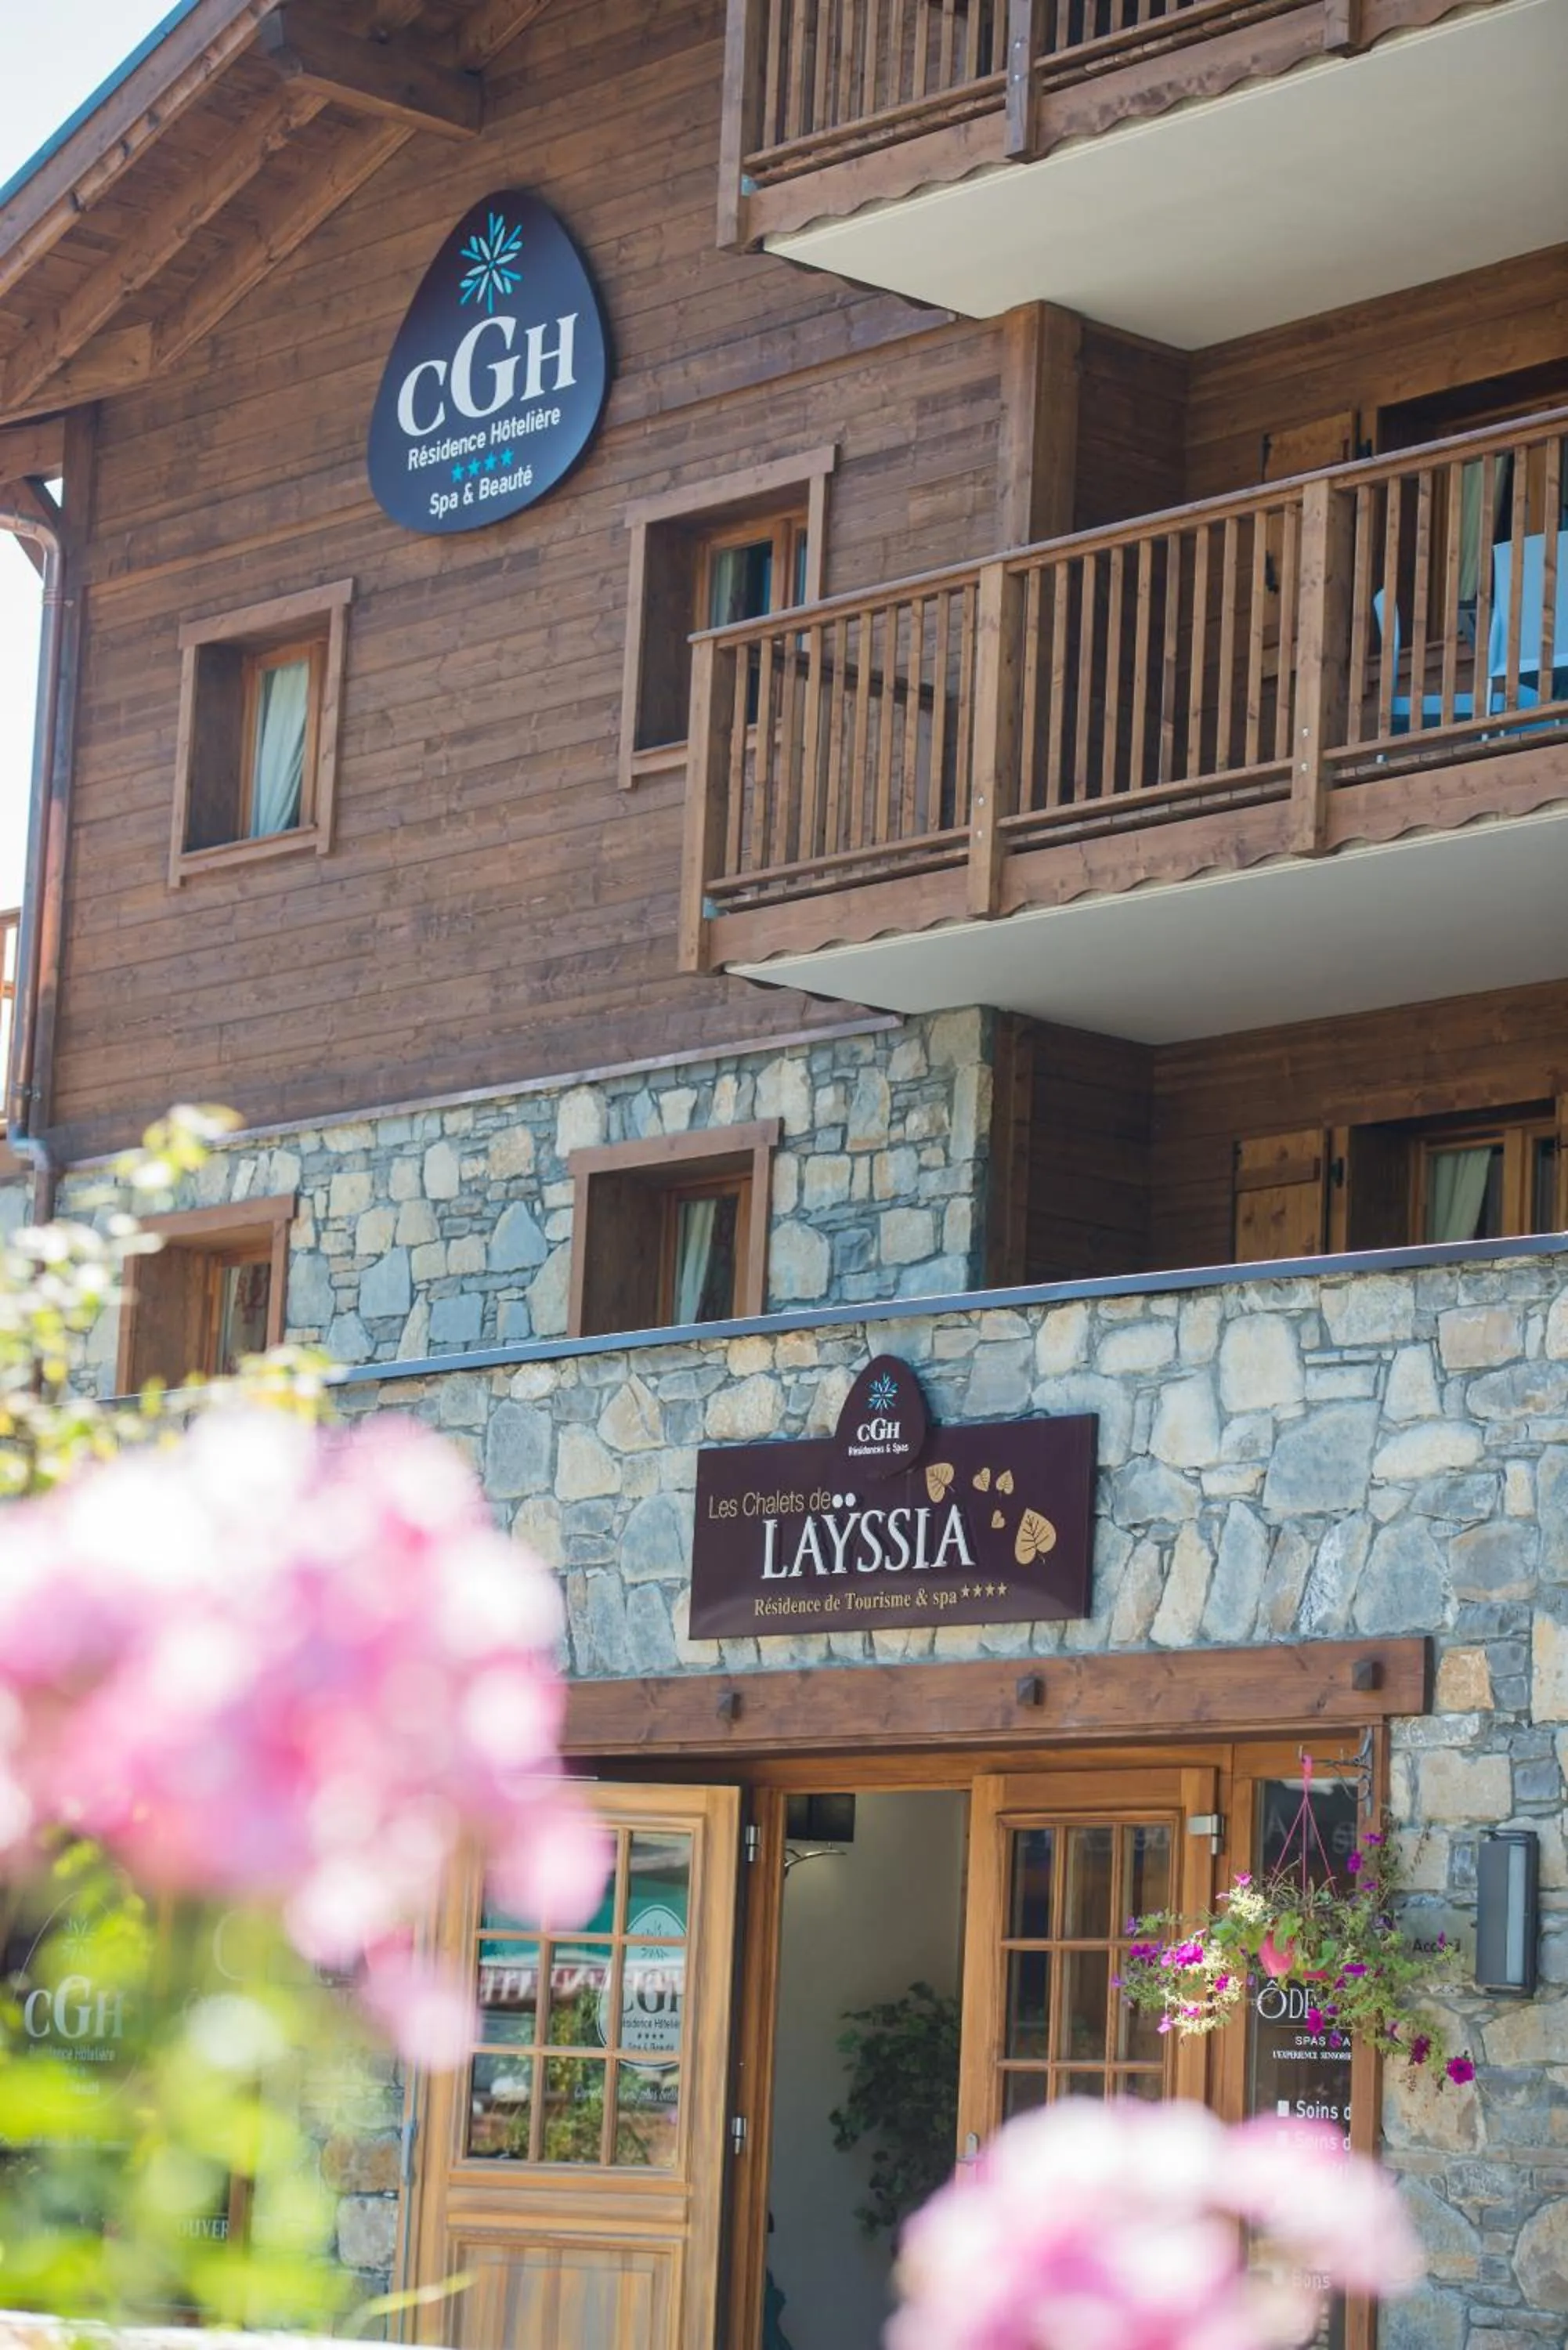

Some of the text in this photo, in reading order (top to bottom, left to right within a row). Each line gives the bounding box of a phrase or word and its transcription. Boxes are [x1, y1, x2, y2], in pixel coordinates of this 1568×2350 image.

[397, 313, 580, 437] CGH
[407, 407, 562, 471] Résidence Hôtelière
[428, 465, 533, 519] Spa & Beauté
[856, 1417, 901, 1442] CGH
[886, 1443, 891, 1453] &
[892, 1442, 909, 1455] Spas
[708, 1487, 832, 1519] Les Chalets de
[754, 1587, 957, 1616] Résidence de Tourisme & spa
[24, 1974, 125, 2039] CGH
[1295, 2036, 1326, 2046] SPAS
[1296, 2099, 1339, 2120] Soins
[1295, 2130, 1338, 2150] Soins
